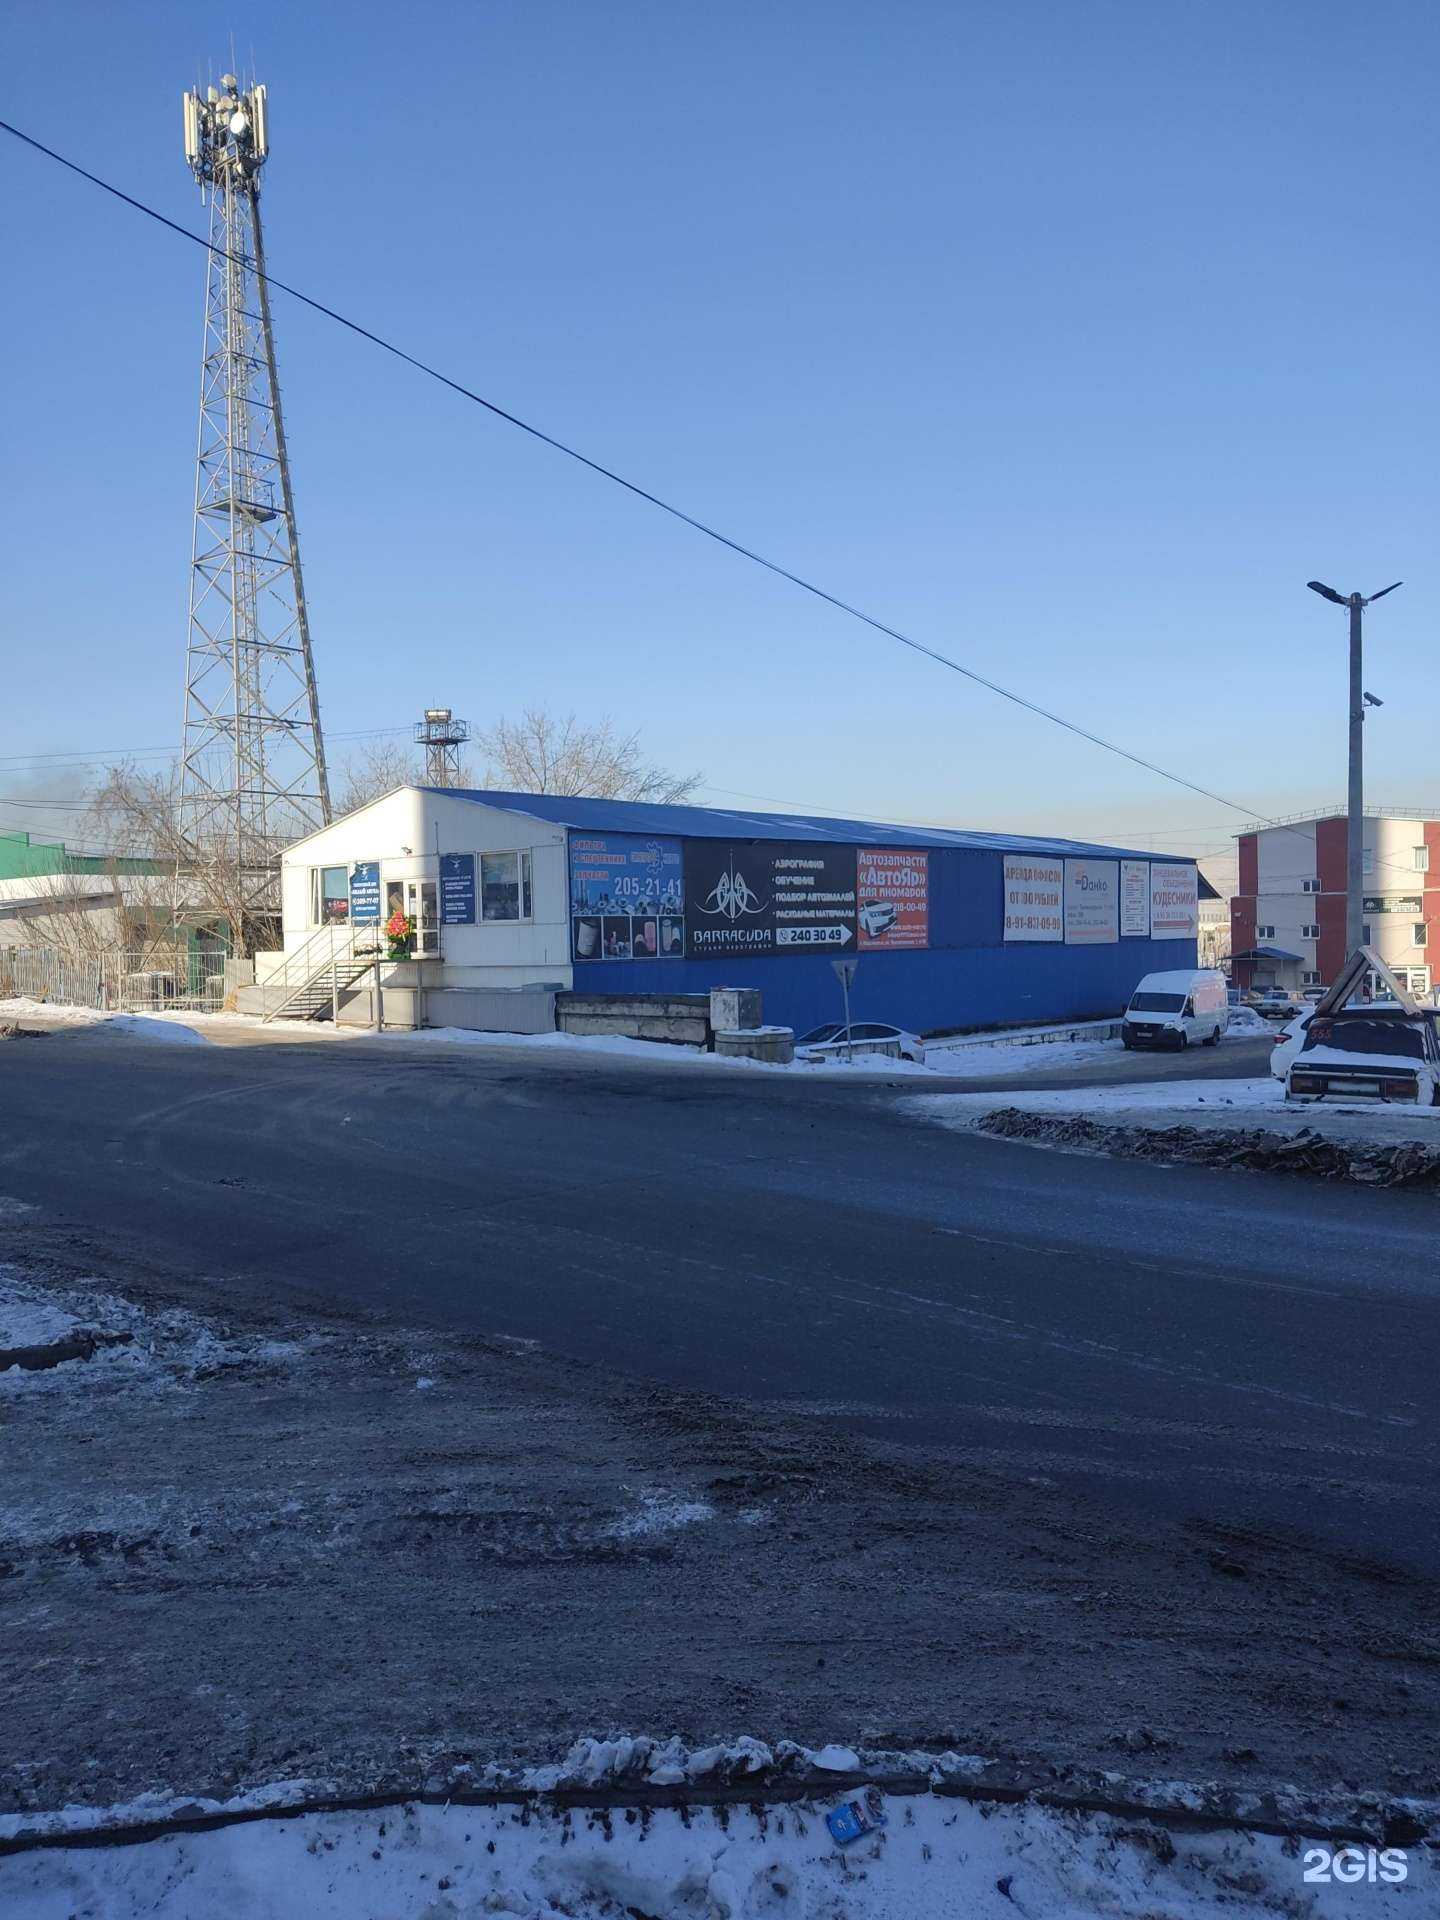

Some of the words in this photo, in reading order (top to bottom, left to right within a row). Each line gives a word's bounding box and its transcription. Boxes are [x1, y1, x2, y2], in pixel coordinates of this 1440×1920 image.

[775, 859, 824, 869] АЭРОГРАФИЯ
[859, 852, 926, 867] Автозапчасти
[775, 875, 814, 885] ОБУЧЕНИЕ
[614, 877, 681, 897] 205-21-41
[859, 887, 877, 897] для
[879, 887, 927, 899] иномарок
[776, 892, 807, 902] ПОДБОР
[1009, 892, 1019, 904] ОТ
[1153, 890, 1196, 909] КУДЕСНИКИ
[816, 908, 856, 918] МАТЕРИАЛЫ
[694, 929, 771, 944] BARRACUDA
[791, 930, 811, 942] 240
[813, 929, 826, 941] 30
[828, 929, 842, 941] 49
